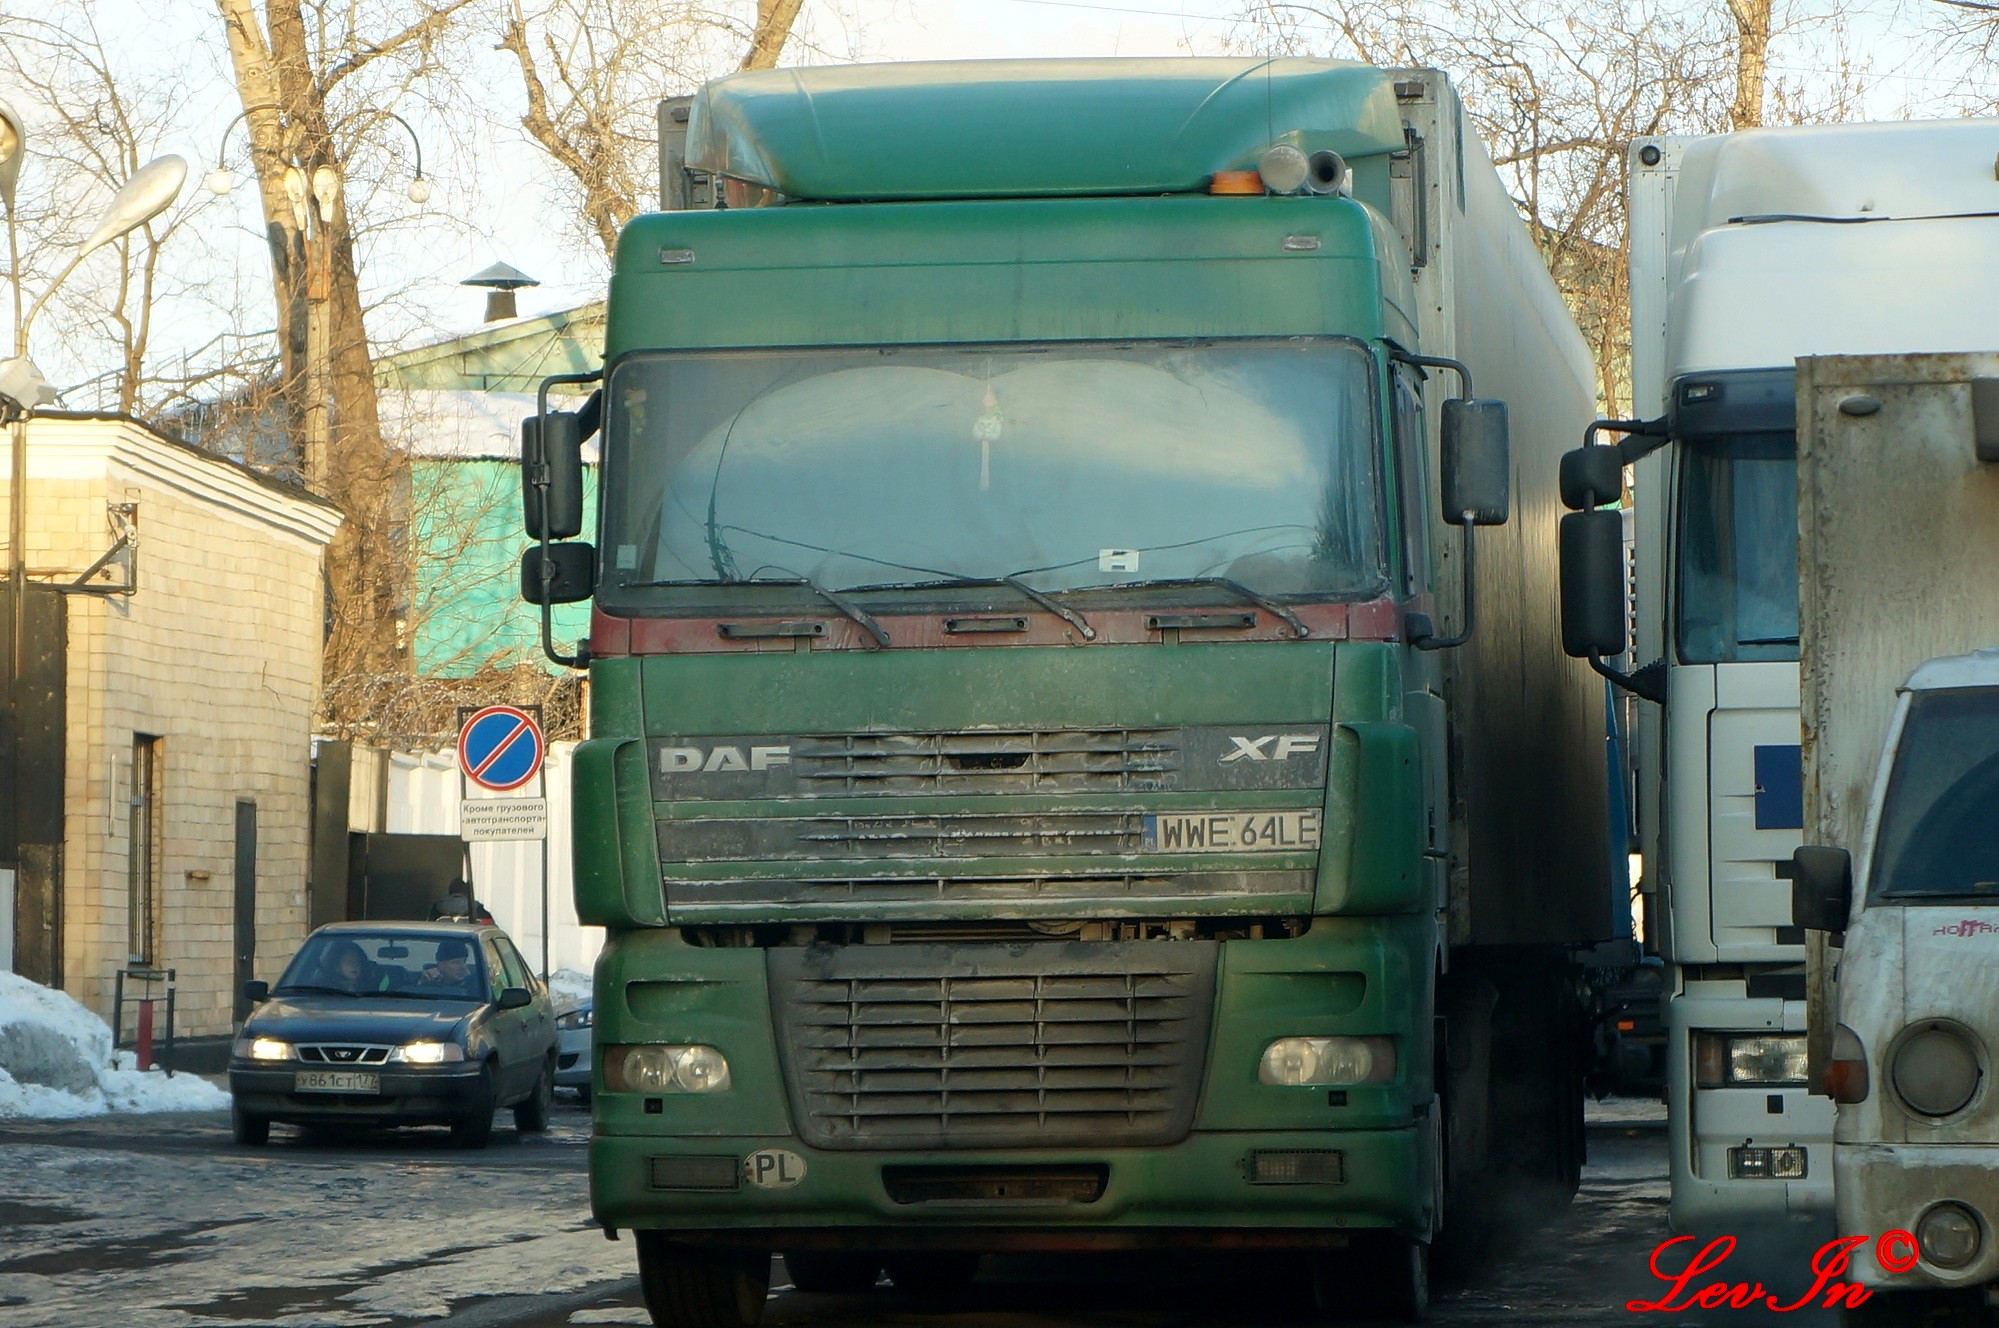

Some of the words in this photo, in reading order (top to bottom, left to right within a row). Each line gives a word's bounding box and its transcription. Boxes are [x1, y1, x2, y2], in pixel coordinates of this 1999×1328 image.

[660, 745, 791, 773] DAF
[1217, 735, 1321, 766] XF
[463, 804, 494, 814] Кроме
[496, 804, 544, 814] грузового
[465, 815, 542, 826] автотранспорта
[473, 826, 535, 836] покупателей
[755, 1153, 796, 1184] PL
